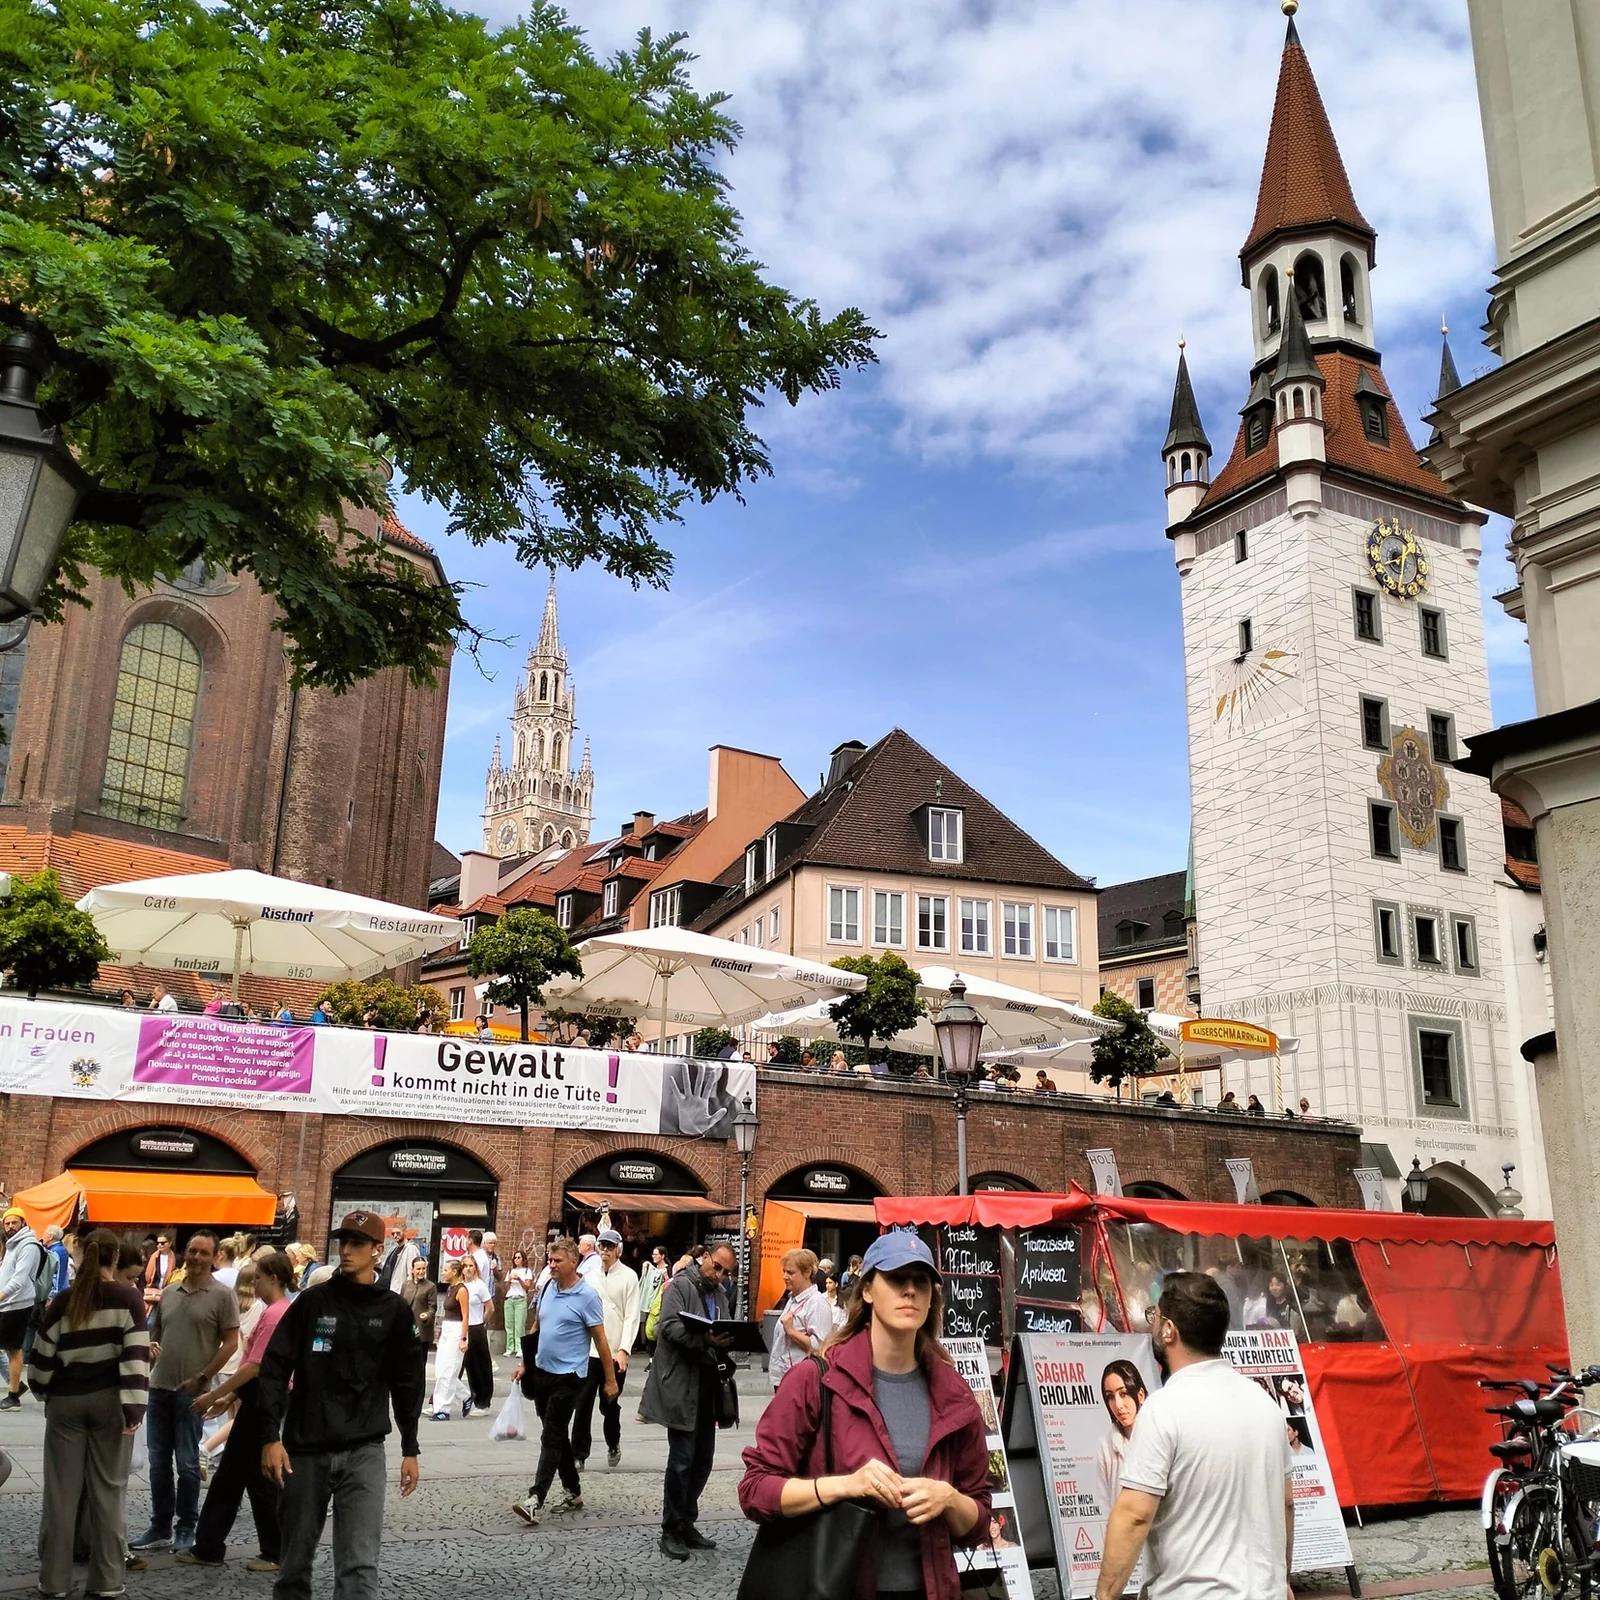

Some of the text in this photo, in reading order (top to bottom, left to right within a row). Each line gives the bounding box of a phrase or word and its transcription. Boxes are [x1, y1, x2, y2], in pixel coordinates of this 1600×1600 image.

[143, 896, 177, 910] Café
[261, 906, 315, 924] Rischart
[369, 916, 444, 935] Restaurant
[711, 958, 752, 973] Rischart
[796, 969, 853, 987] Restaurant
[20, 1022, 96, 1044] Frauen
[172, 1019, 288, 1039] Hilfe und Unterstützung
[162, 1030, 180, 1039] Help
[198, 1034, 230, 1042] support
[237, 1036, 254, 1045] Aide
[265, 1040, 294, 1048] support
[188, 1043, 223, 1052] supporto
[271, 1050, 295, 1058] destek
[148, 1060, 182, 1070] Помощь
[224, 1055, 250, 1064] Pomoc
[257, 1059, 290, 1068] wsparcie
[438, 1040, 565, 1081] Gewalt
[225, 1076, 257, 1086] podrška
[243, 1067, 301, 1079] Ajutor sprijin
[167, 1086, 189, 1095] Chillig
[394, 1072, 600, 1102] kommt nicht in die Tüte
[332, 1087, 351, 1095] Hilfe
[369, 1089, 423, 1100] Unterstützung
[432, 1093, 495, 1105] Krisensituationen
[509, 1100, 556, 1109] sexualisierter
[557, 1102, 580, 1110] Gewalt
[602, 1106, 647, 1115] Partnergewalt
[435, 1104, 463, 1112] Menschen
[1090, 1154, 1115, 1165] HOLZ
[944, 1224, 978, 1244] Frische
[1020, 1230, 1075, 1253] Französische
[945, 1248, 995, 1275] Pfifferlinge
[1020, 1258, 1067, 1289] Aprikosen
[1249, 1336, 1259, 1347] IM
[1261, 1332, 1291, 1348] IRAN
[1238, 1349, 1295, 1364] VERURTEILT
[1035, 1362, 1086, 1383] SAGHAR
[1040, 1385, 1099, 1405] GHOLAMI.
[1056, 1481, 1078, 1494] BITTE
[1058, 1494, 1094, 1506] LASST MICH
[1060, 1507, 1078, 1518] NICHT
[1072, 1552, 1101, 1562] WICHTIGE
